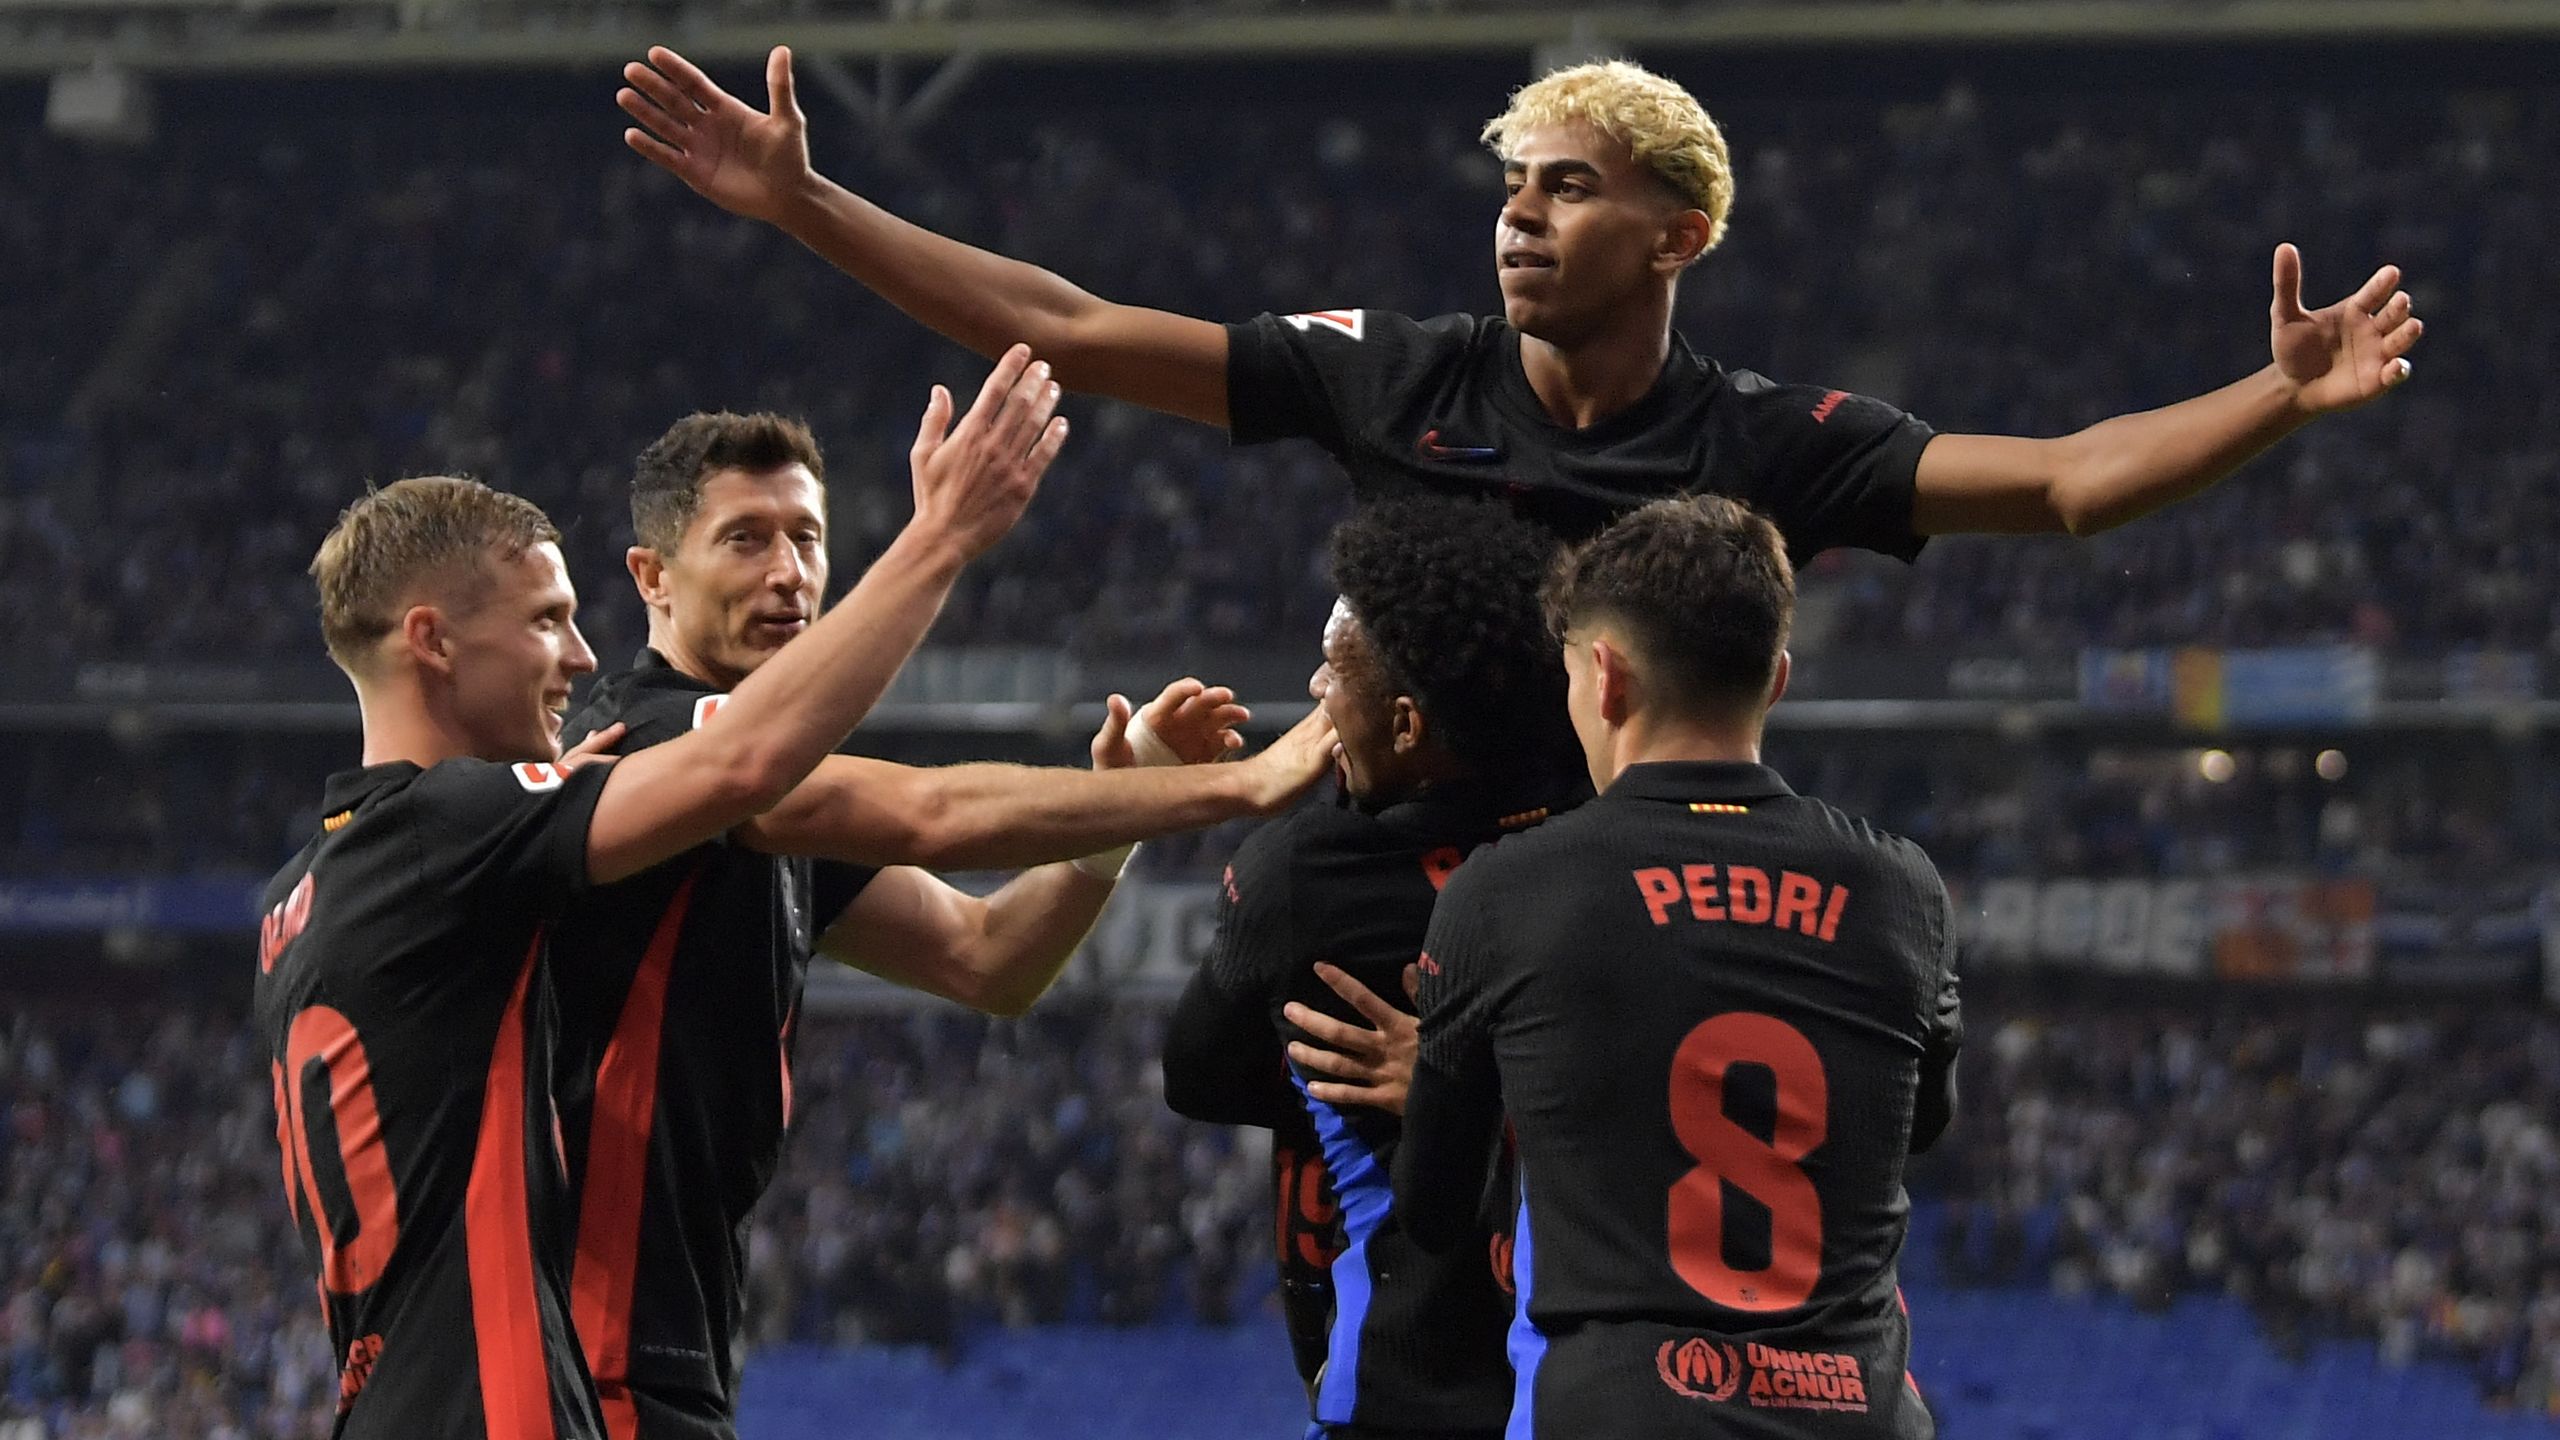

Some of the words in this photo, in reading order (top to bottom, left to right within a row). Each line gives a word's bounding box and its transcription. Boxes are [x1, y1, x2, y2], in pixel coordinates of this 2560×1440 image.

[1633, 863, 1850, 943] PEDRI
[272, 1004, 399, 1327] 0
[1668, 1011, 1828, 1312] 8
[1747, 1343, 1861, 1378] UNHCR
[1749, 1369, 1866, 1402] ACNUR
